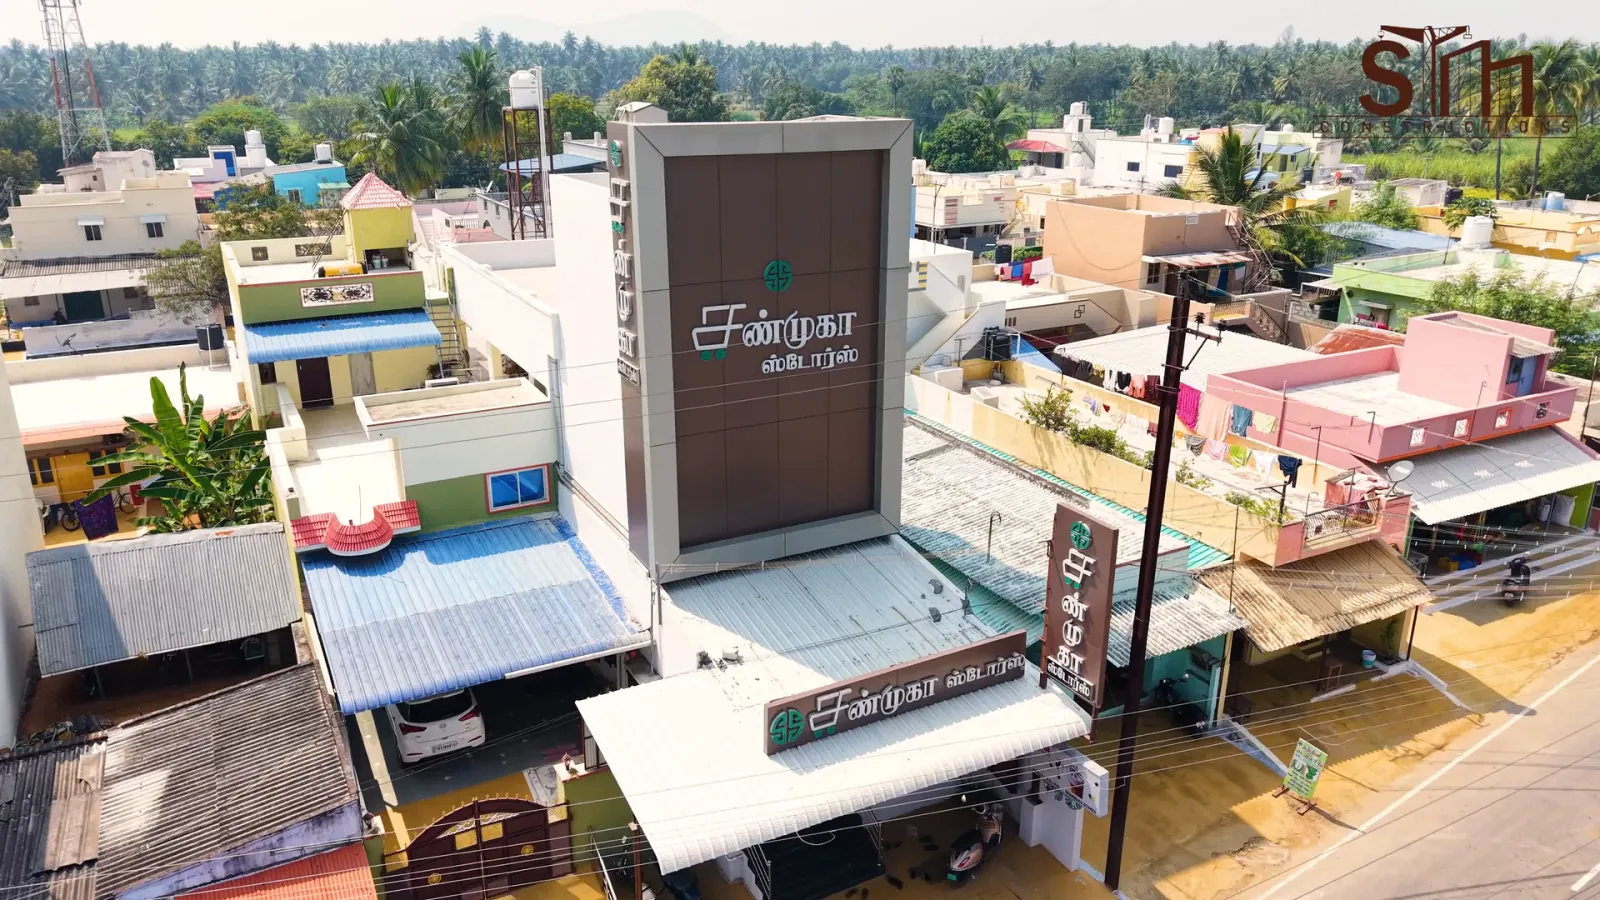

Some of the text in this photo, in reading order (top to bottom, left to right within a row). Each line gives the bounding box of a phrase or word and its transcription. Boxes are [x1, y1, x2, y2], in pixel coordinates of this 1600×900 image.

[692, 303, 857, 350] சண்முகா
[762, 345, 858, 374] ஸ்டோர்ஸ்
[809, 677, 939, 732] சண்முகா
[946, 652, 1026, 688] ஸ்டோர்ஸ்
